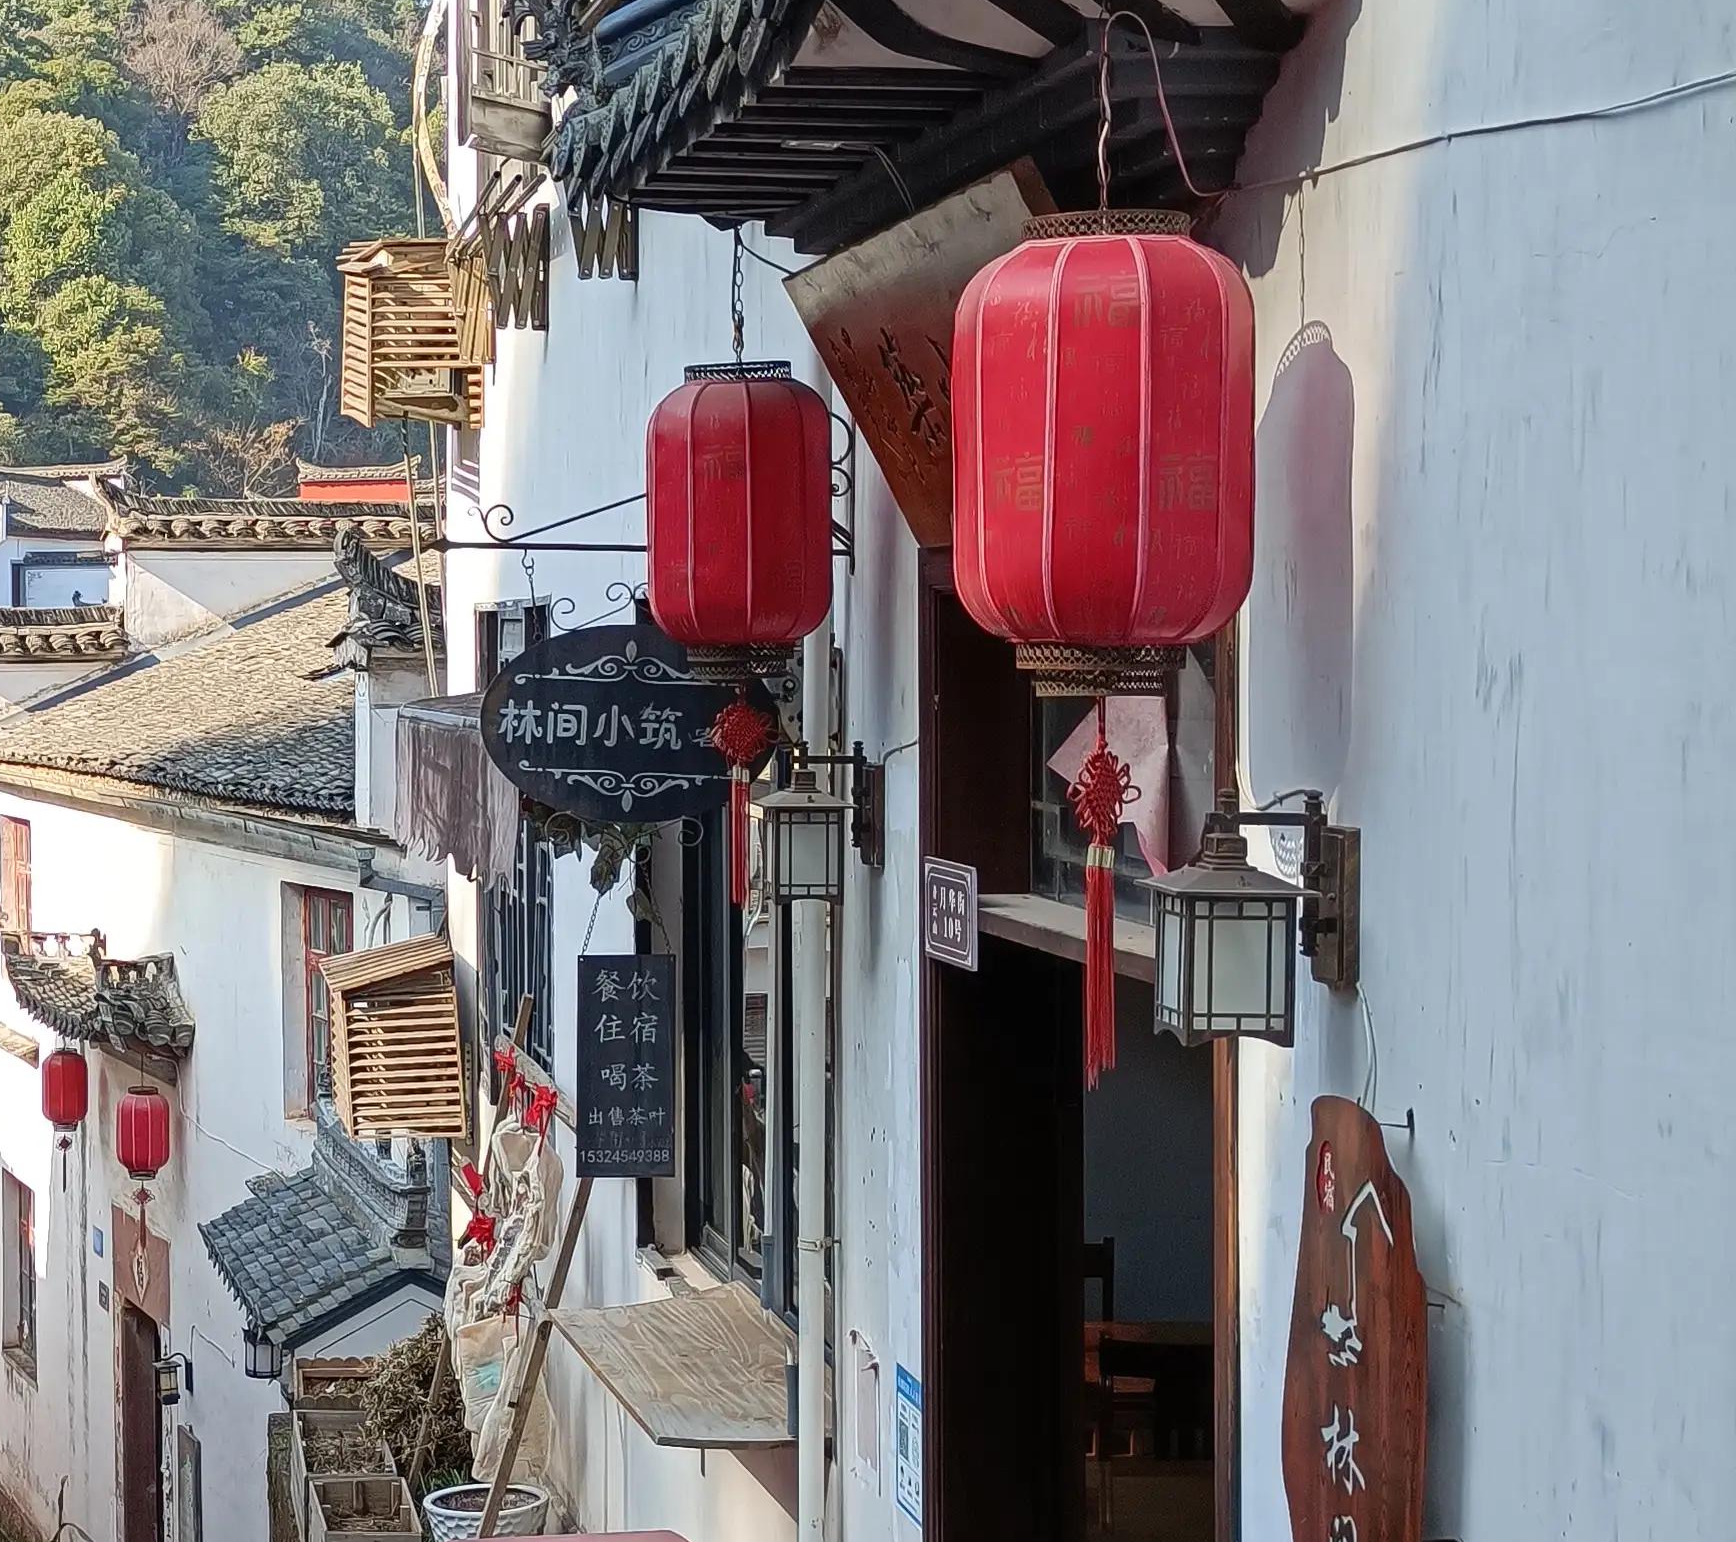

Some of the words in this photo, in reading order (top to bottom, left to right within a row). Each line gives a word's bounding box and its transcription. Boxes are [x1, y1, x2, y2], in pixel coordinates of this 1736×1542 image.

[497, 698, 684, 751] 林间小筑
[939, 886, 965, 916] 月华街
[943, 916, 962, 943] 10号
[592, 969, 661, 1003] 餐饮
[593, 1011, 659, 1044] 住宿
[600, 1062, 659, 1092] 喝茶
[588, 1106, 666, 1127] 出售茶叶
[579, 1149, 671, 1164] 15324549388
